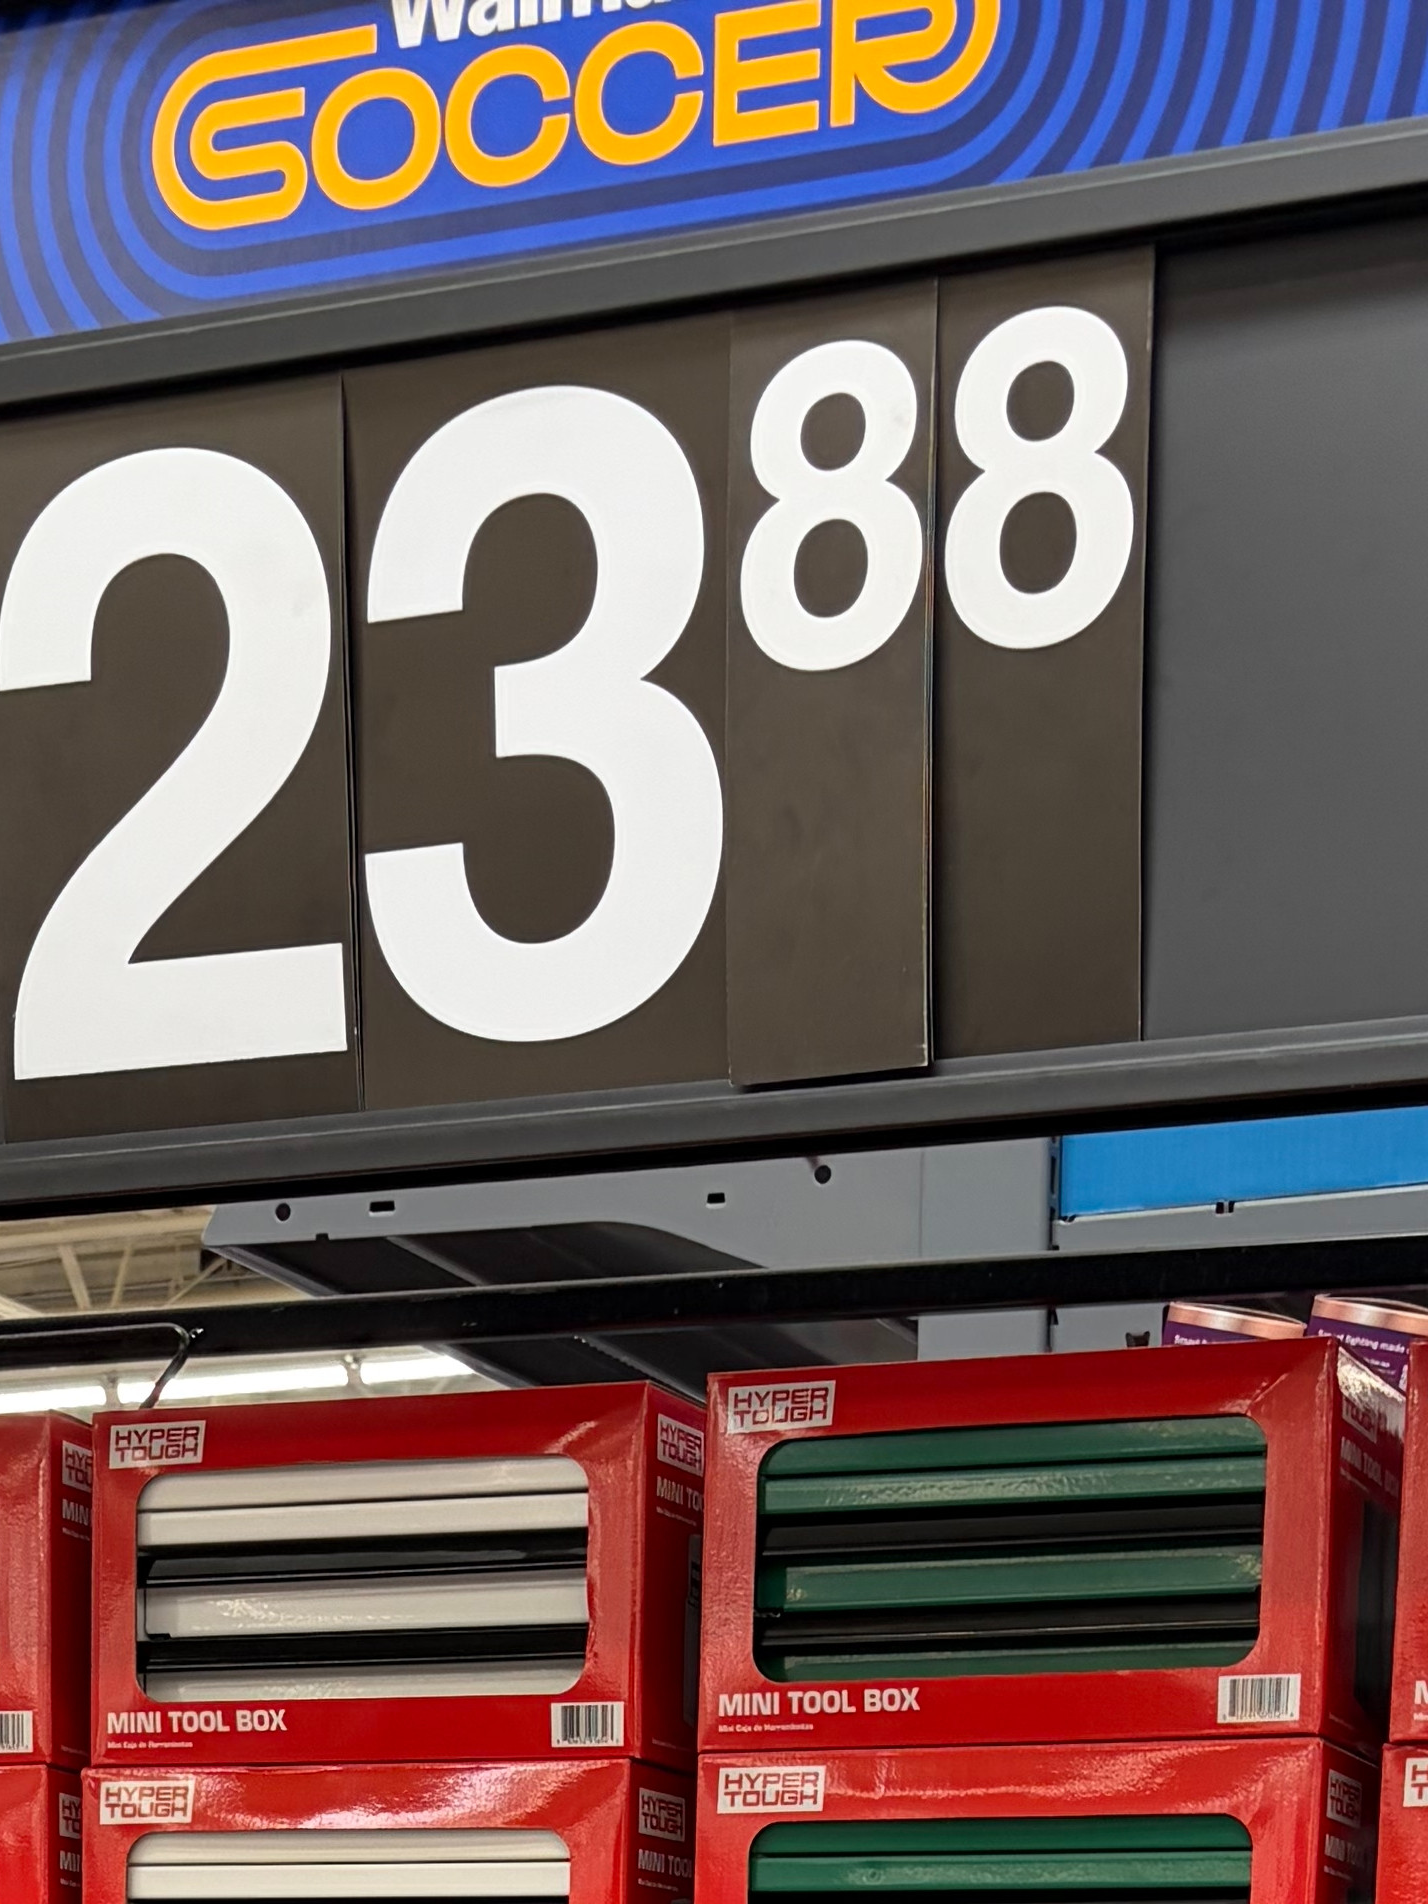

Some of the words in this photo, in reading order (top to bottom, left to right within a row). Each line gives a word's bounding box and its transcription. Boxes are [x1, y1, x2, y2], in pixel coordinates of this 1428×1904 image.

[151, 0, 1000, 231] SOCCER
[724, 1770, 820, 1792] HYPER
[723, 1788, 819, 1808] TOUGH
